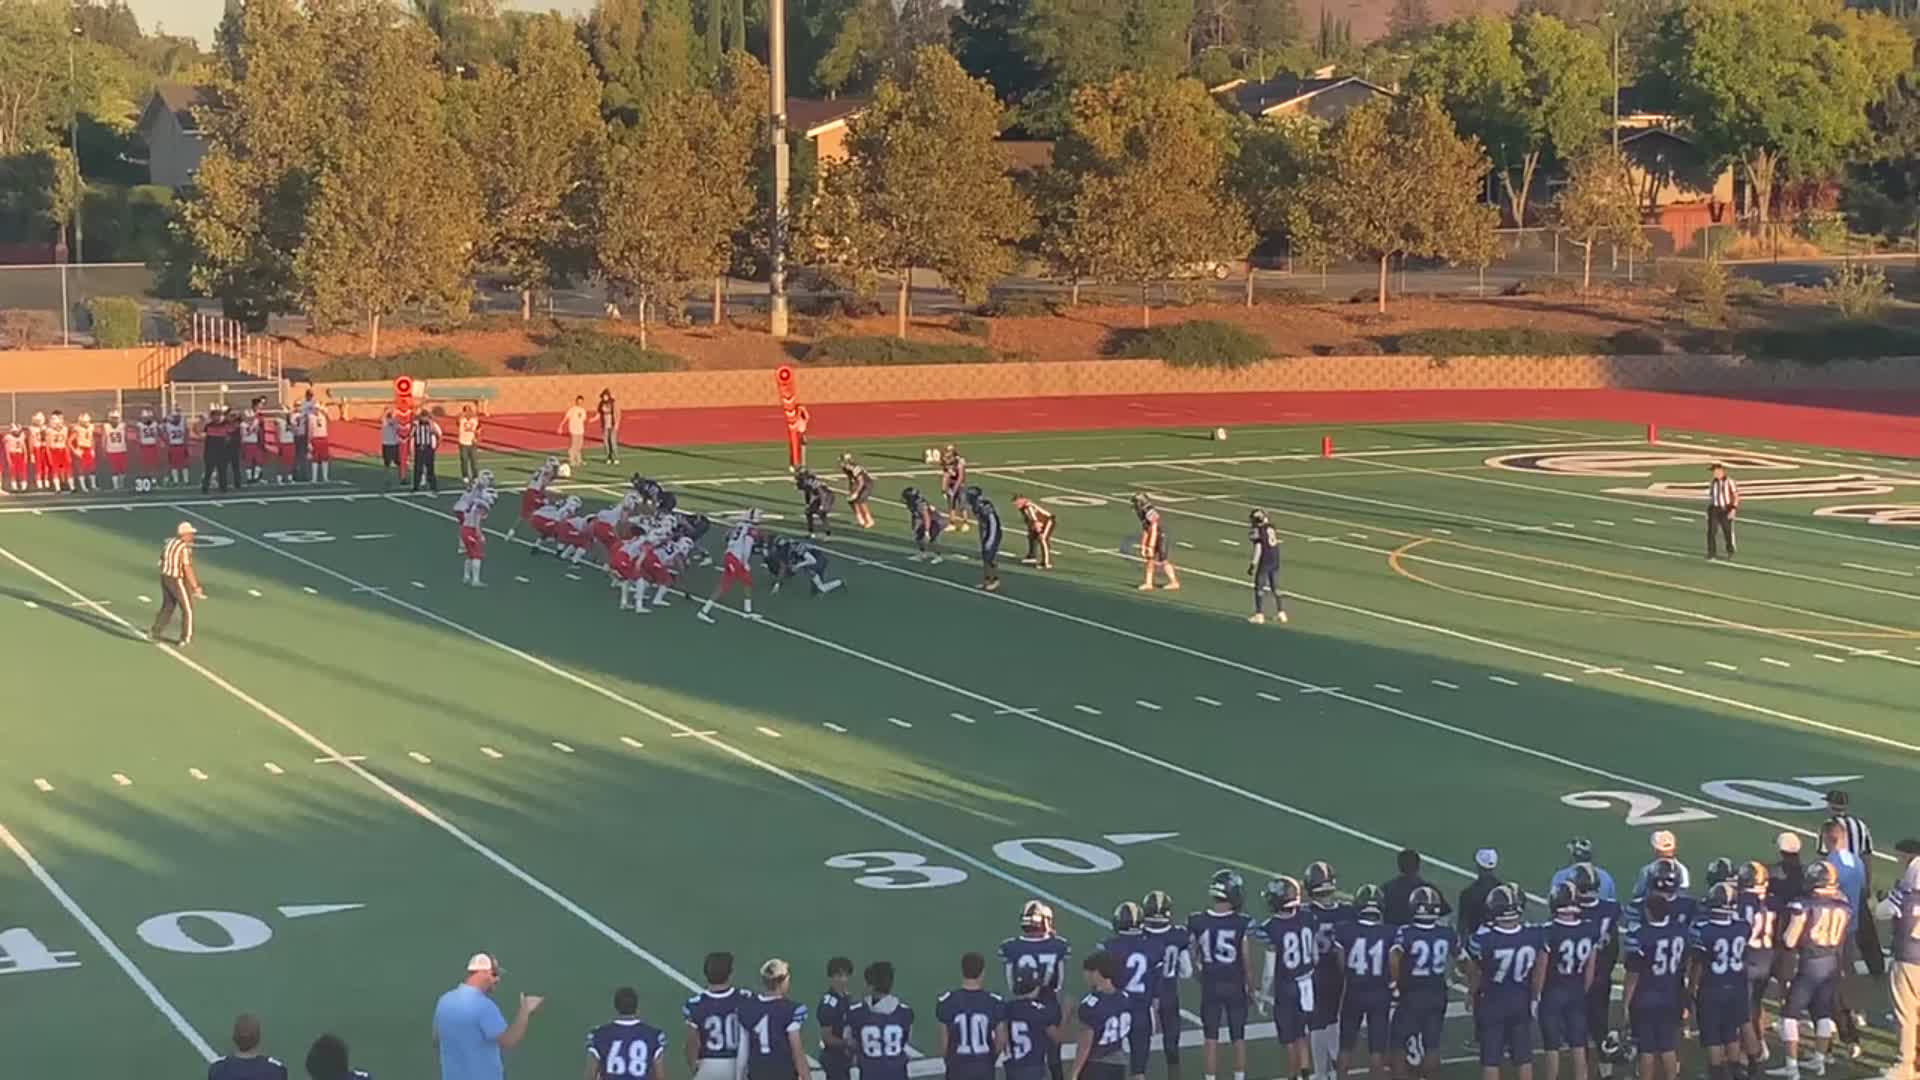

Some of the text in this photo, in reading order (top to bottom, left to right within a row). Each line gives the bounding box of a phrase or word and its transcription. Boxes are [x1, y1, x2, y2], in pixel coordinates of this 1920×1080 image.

[926, 450, 941, 464] 10
[135, 478, 151, 492] 30
[1560, 779, 1829, 826] 20
[824, 838, 1124, 888] 30
[1199, 927, 1238, 963] 15
[1810, 907, 1848, 946] 40
[1283, 926, 1320, 969] 80
[1347, 937, 1384, 976] 41
[1493, 946, 1537, 983] 70
[1125, 951, 1148, 993] 2
[704, 1014, 742, 1050] 30
[753, 1015, 772, 1054] 1
[861, 1025, 904, 1058] 68
[954, 1012, 990, 1055] 10
[606, 1040, 649, 1077] 68
